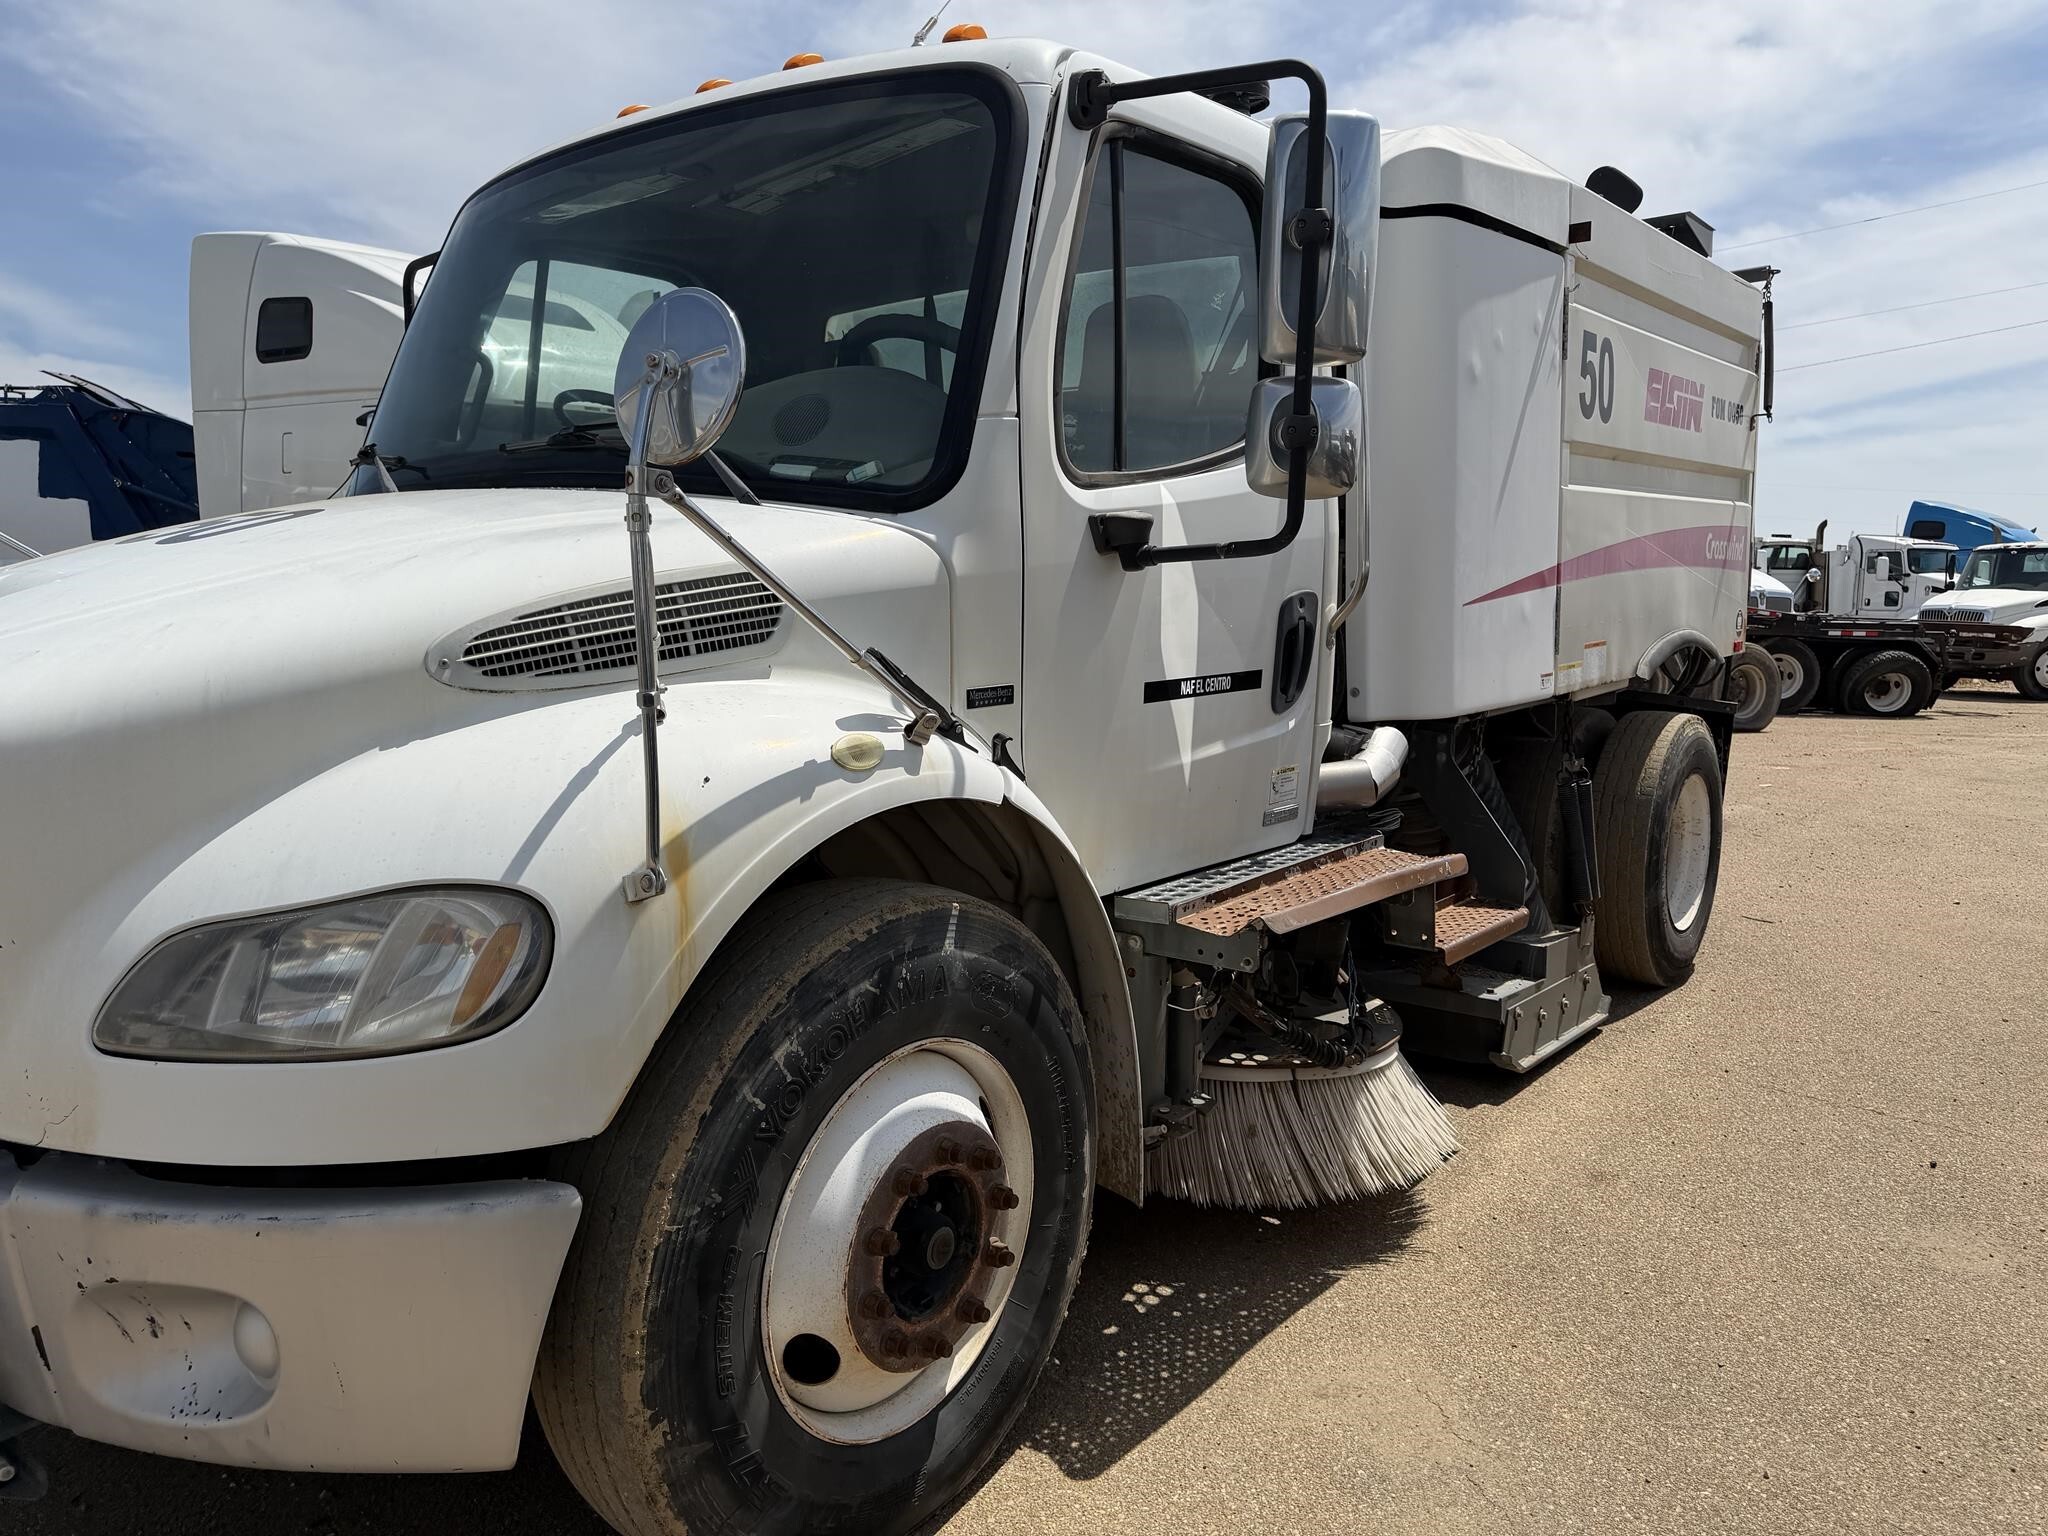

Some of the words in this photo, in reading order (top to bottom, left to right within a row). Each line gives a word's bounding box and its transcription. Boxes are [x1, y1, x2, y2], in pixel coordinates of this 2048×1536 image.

[1579, 329, 1615, 424] 50
[1644, 367, 1705, 433] ELGIN
[1180, 679, 1196, 695] NAF
[1196, 678, 1205, 694] EL
[1205, 675, 1232, 692] CENTRO
[754, 963, 951, 1142] YOKOHAMA
